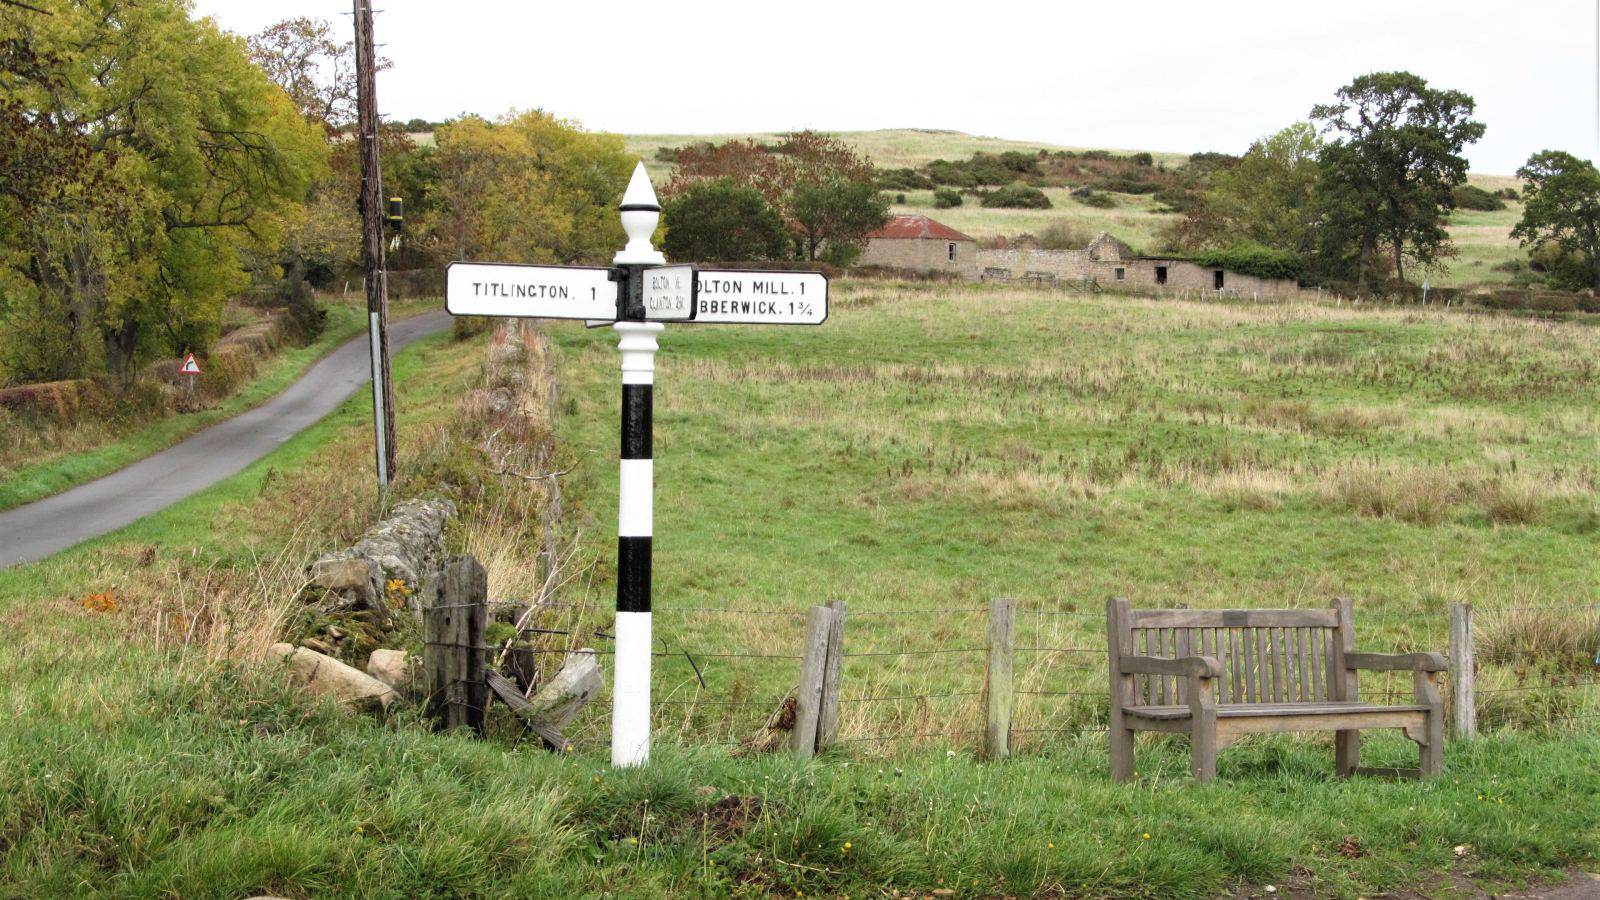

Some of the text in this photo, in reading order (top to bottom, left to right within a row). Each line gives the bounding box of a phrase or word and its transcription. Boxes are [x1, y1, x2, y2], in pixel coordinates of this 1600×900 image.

[590, 287, 596, 301] 1
[697, 280, 742, 294] OLTON
[800, 282, 805, 295] 1
[700, 300, 782, 315] BBERWICK.
